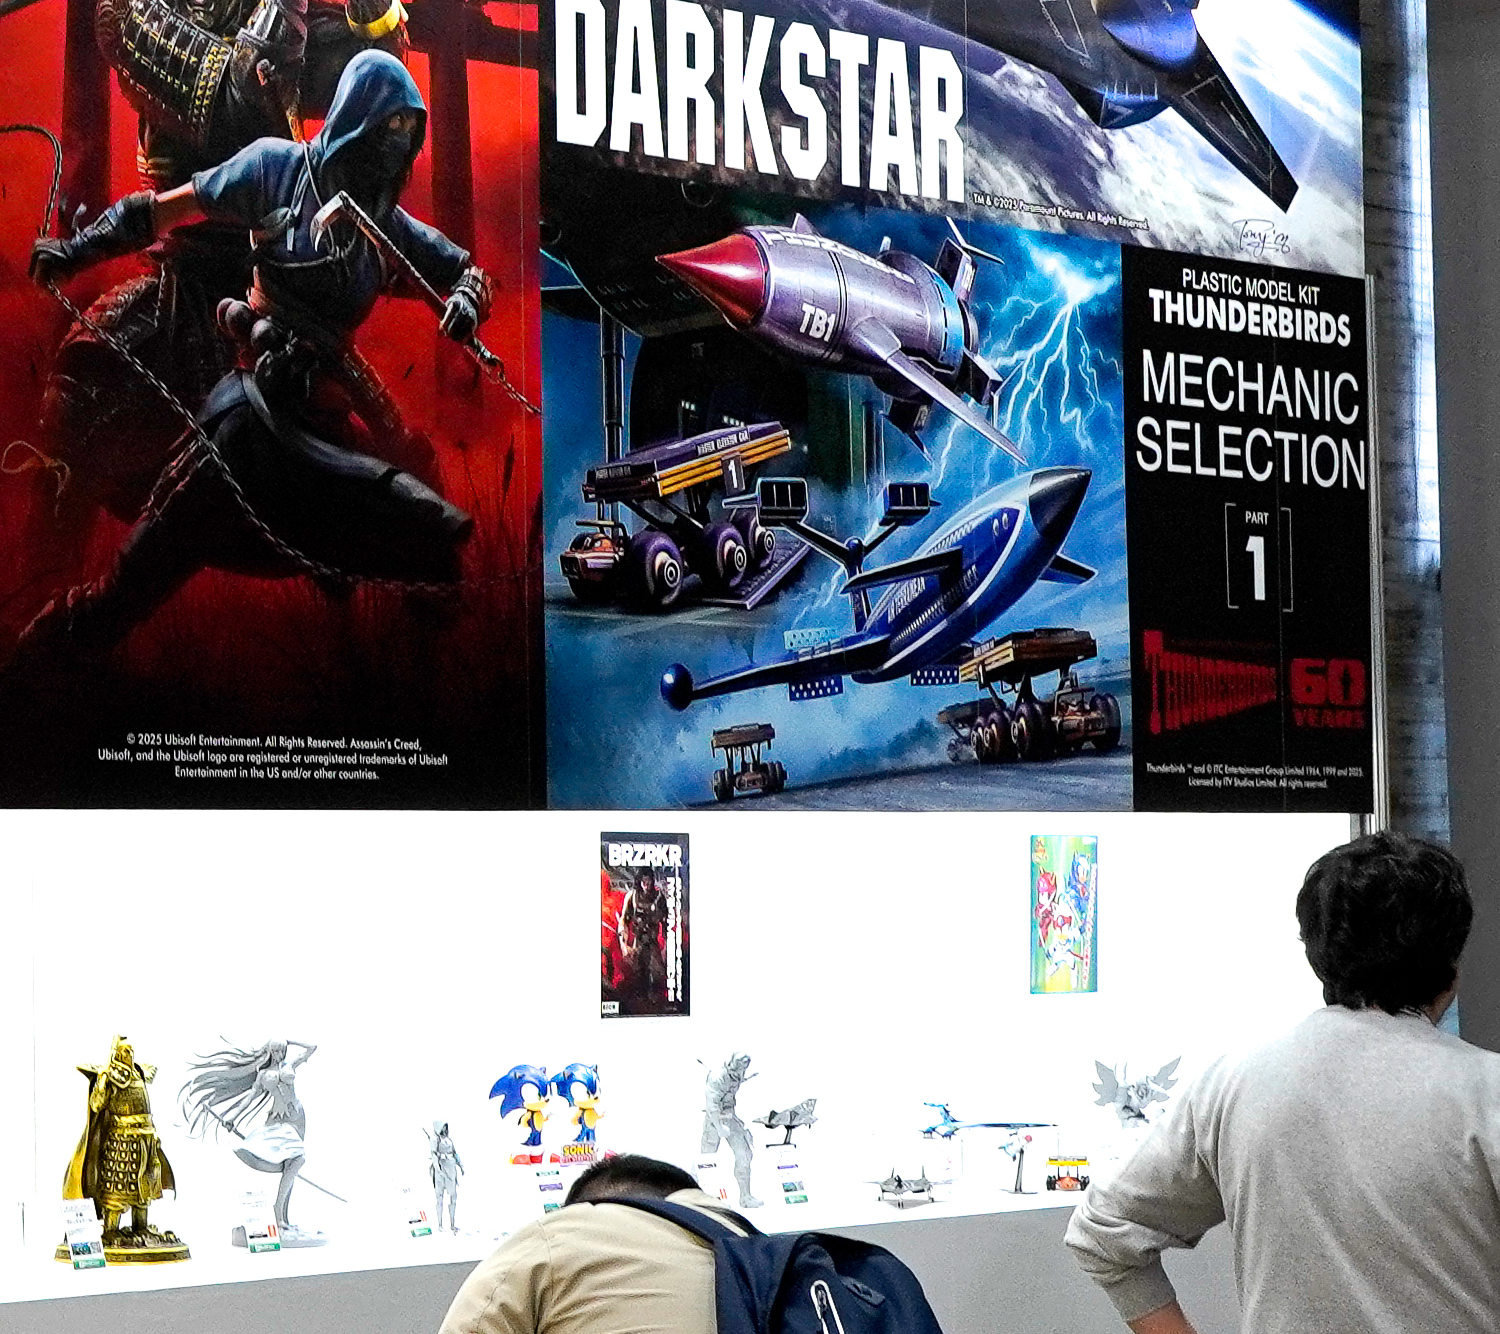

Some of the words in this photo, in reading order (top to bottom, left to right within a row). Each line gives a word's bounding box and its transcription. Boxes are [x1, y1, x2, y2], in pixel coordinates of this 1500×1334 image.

[1086, 210, 1097, 222] All
[1181, 267, 1243, 296] PLASTIC
[1245, 277, 1296, 304] MODEL
[1299, 285, 1321, 306] KIT
[799, 302, 837, 343] TB1
[1149, 288, 1351, 348] THUNDERBIRDS
[1142, 348, 1360, 426] MECHANIC
[1136, 415, 1366, 491] SELECTION
[1245, 510, 1270, 526] PART
[1245, 534, 1266, 602] 1
[1290, 656, 1366, 707] 60
[98, 748, 134, 763] Ubisoft,
[136, 748, 154, 761] and
[156, 749, 171, 761] the
[173, 749, 205, 762] Ubisoft
[207, 749, 227, 764] logo
[229, 753, 245, 763] are
[246, 751, 290, 765] registered
[292, 753, 302, 764] or
[303, 752, 357, 766] unregistered
[359, 752, 407, 765] trademarks
[408, 753, 417, 765] of
[418, 754, 448, 766] Ubisoft
[137, 733, 162, 746] 2025
[164, 733, 197, 746] Ubisoft
[199, 734, 263, 747] Entertainment.
[265, 735, 277, 748] All
[279, 735, 306, 751] Rights
[307, 736, 348, 750] Reserved.
[350, 737, 392, 751] Assassin's
[393, 738, 423, 752] Creed,
[174, 765, 237, 778] Entertainment
[239, 766, 248, 778] in
[250, 766, 264, 778] the
[266, 766, 280, 779] US
[281, 767, 312, 780] and/or
[313, 768, 337, 779] other
[338, 768, 379, 780] countries.
[608, 842, 683, 867] BRZRKR
